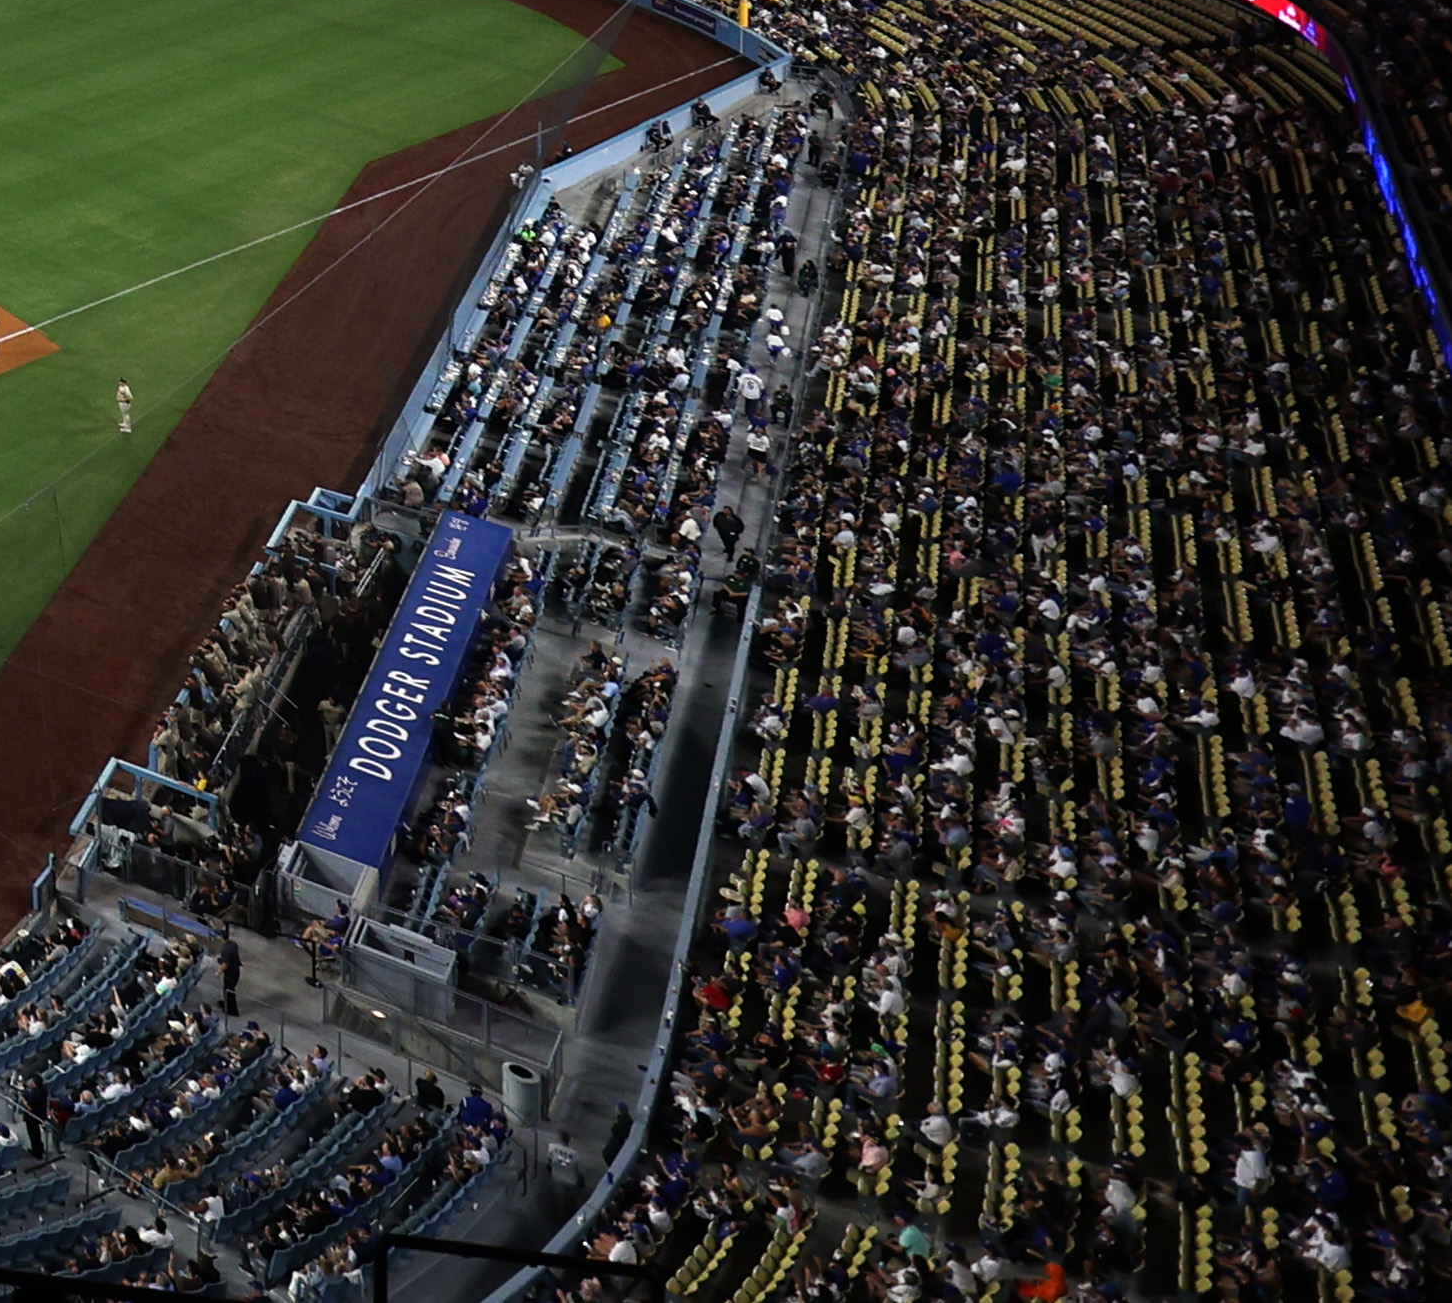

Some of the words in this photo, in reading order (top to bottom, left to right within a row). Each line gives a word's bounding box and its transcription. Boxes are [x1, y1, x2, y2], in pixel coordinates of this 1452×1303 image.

[349, 669, 430, 781] DODGER
[399, 562, 476, 666] STADIUM
[328, 775, 358, 807] ようこそ
